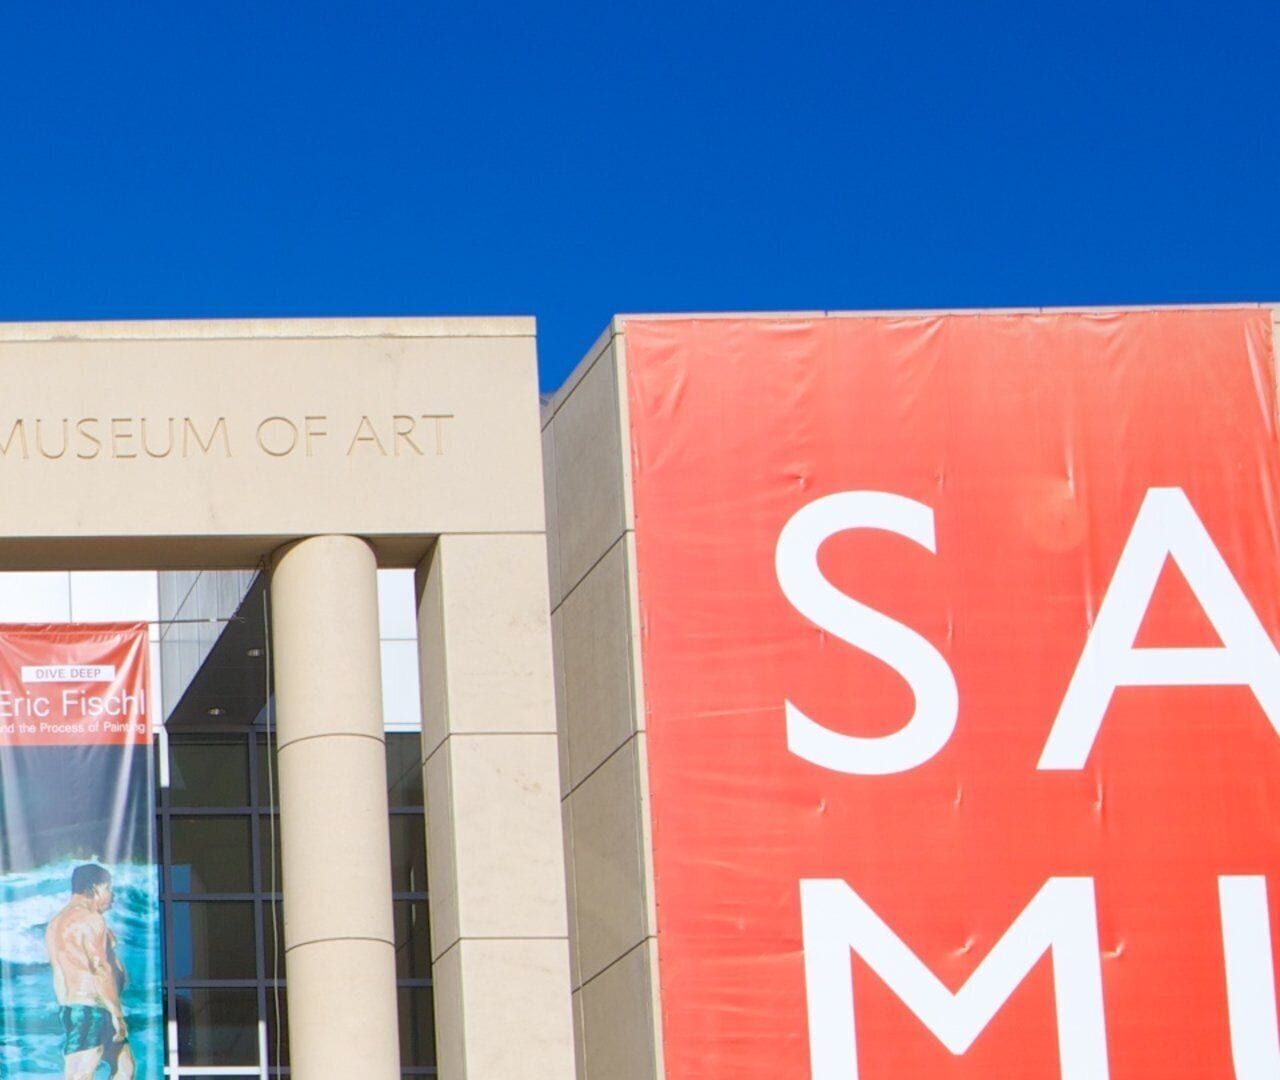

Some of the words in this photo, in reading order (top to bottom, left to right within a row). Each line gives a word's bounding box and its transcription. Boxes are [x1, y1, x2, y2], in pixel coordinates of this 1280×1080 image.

[255, 416, 328, 458] OF
[346, 414, 455, 457] ART
[774, 486, 1280, 776] SA
[35, 668, 67, 680] DIVE
[70, 667, 101, 679] DEEP
[61, 688, 146, 717] Fischl
[19, 722, 37, 734] the
[40, 722, 85, 734] Process
[88, 720, 100, 733] of
[103, 720, 146, 735] Paintng
